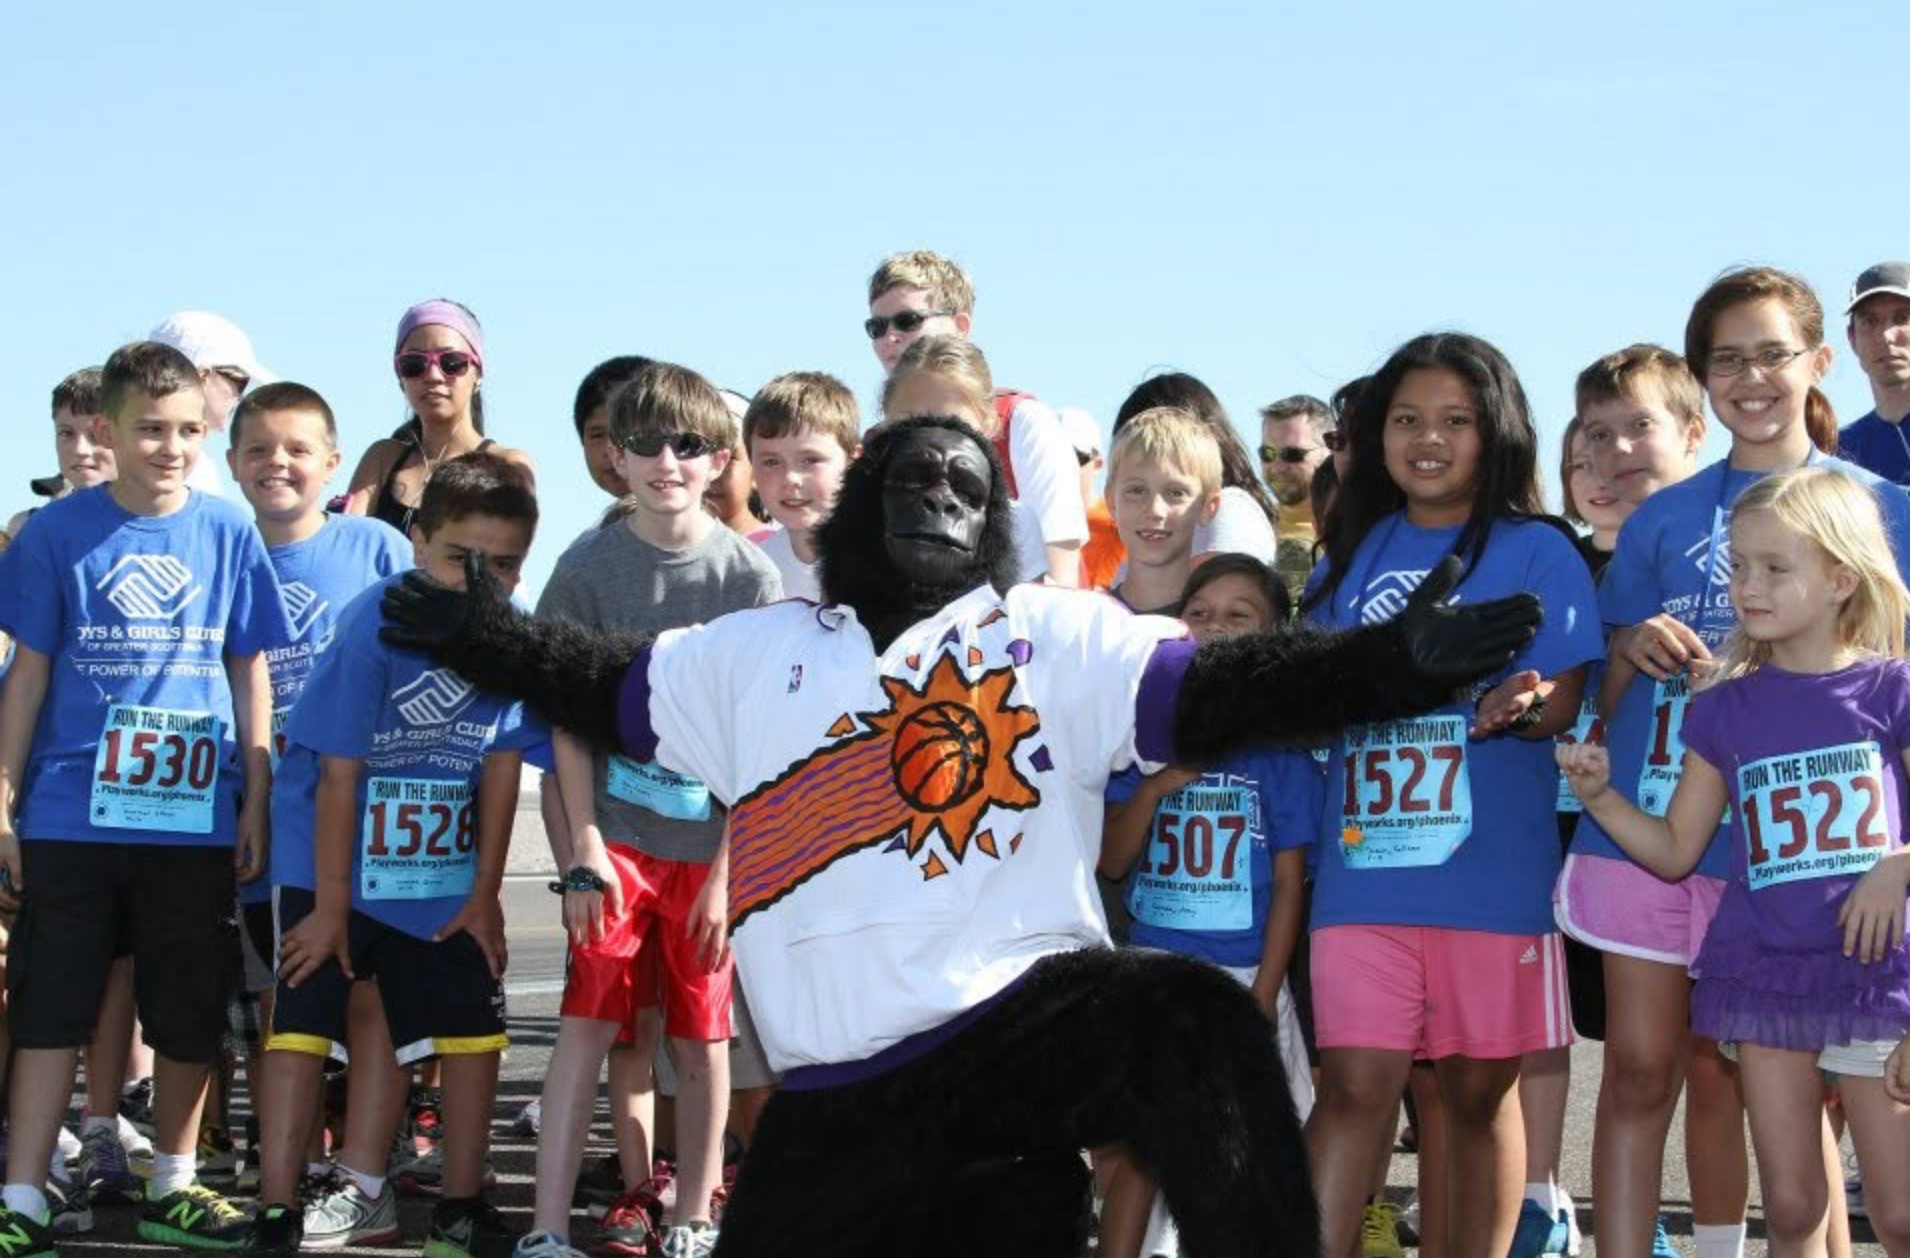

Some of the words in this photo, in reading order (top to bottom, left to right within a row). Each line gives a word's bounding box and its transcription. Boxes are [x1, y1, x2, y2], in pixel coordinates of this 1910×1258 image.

[110, 625, 124, 640] &
[127, 626, 181, 640] GIRLS
[89, 664, 139, 676] POWER
[141, 664, 161, 677] OF
[112, 708, 139, 727] RUN
[141, 711, 164, 730] THE
[166, 714, 215, 733] RUNWAY
[1396, 720, 1457, 744] RUNWAY
[98, 729, 217, 790] 1530
[1743, 764, 1770, 791] RUN
[1772, 758, 1803, 784] THE
[1805, 748, 1871, 778] RUNWAY
[376, 781, 401, 800] RUN
[404, 783, 427, 801] THE
[1344, 744, 1463, 816] 1527
[1186, 789, 1241, 812] RUNWAY
[367, 801, 475, 856] 1528
[1742, 775, 1887, 866] 1522
[1140, 812, 1246, 880] 507
